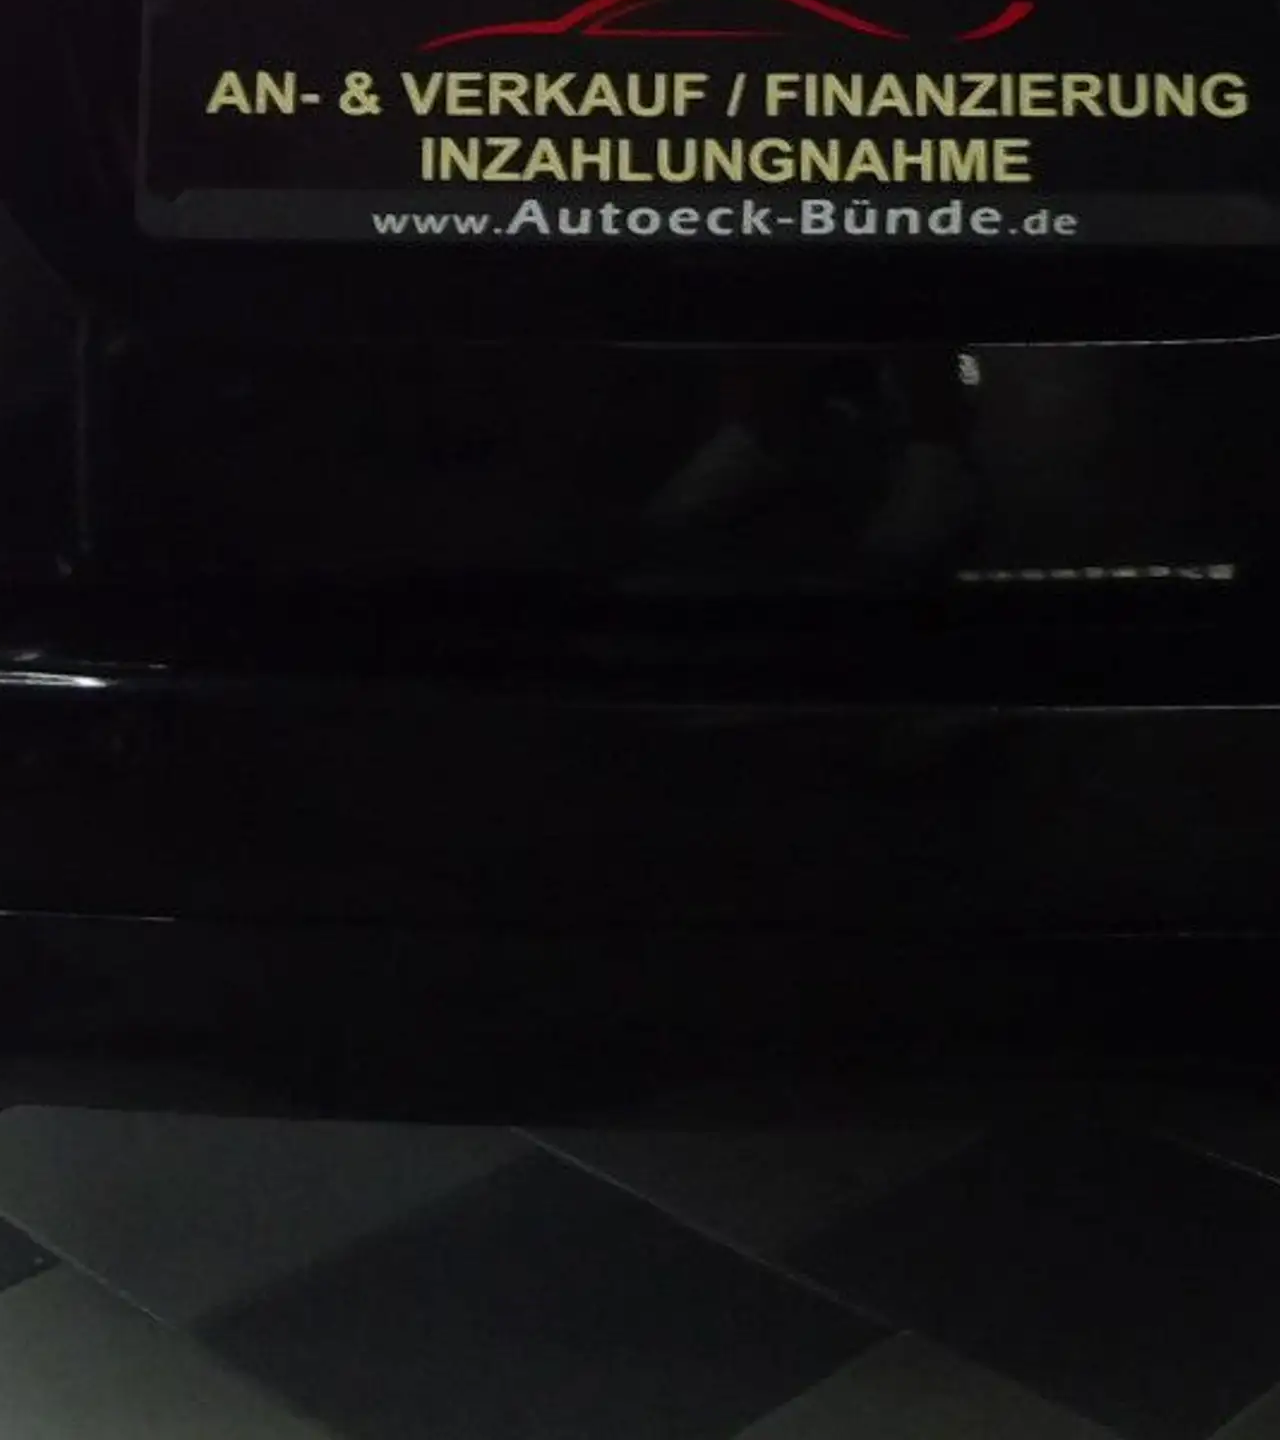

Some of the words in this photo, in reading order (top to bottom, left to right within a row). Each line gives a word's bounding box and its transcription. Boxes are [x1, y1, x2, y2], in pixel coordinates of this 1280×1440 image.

[206, 70, 320, 116] AN-
[339, 71, 382, 117] &
[400, 71, 709, 117] VERKAUF
[726, 72, 746, 117] /
[765, 72, 1248, 118] FINANZIERUNG
[421, 136, 1032, 183] INZAHLUNGNAHME
[372, 198, 1079, 236] www.Autoeck-Bünde.de
